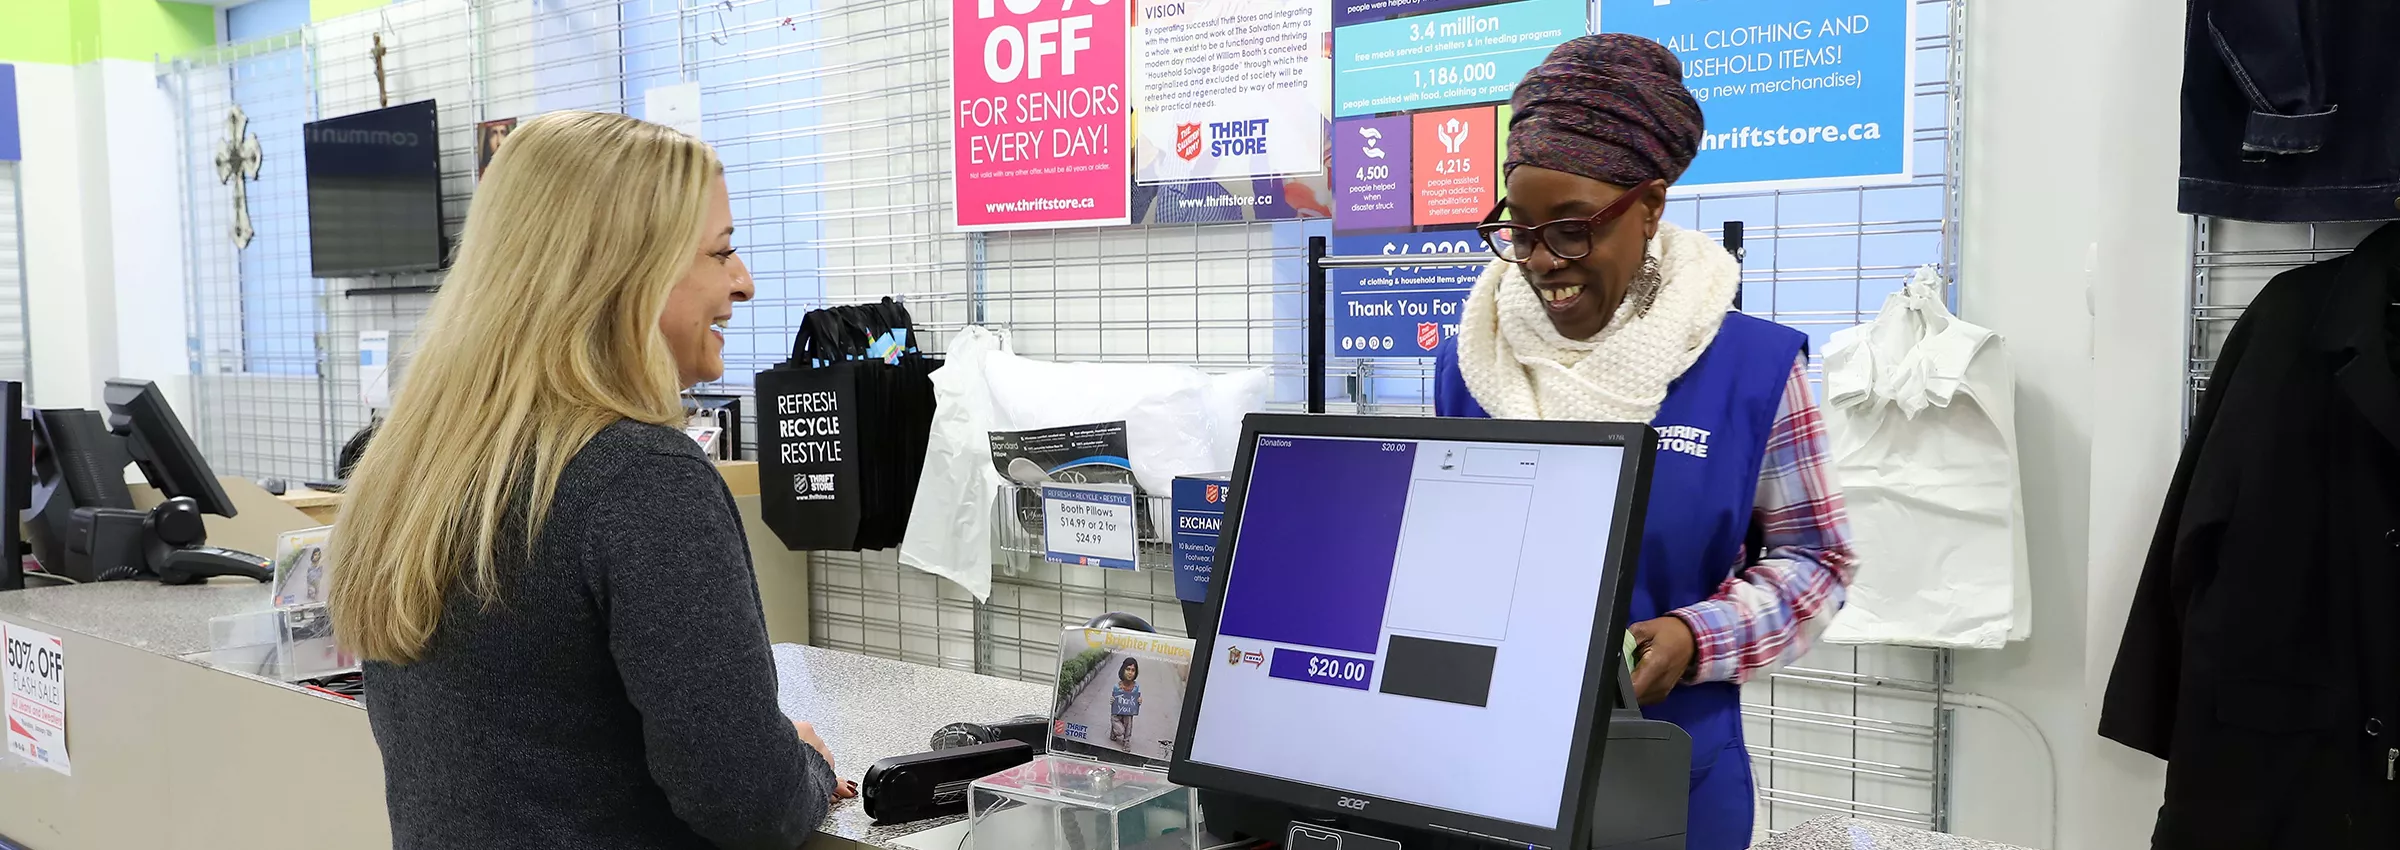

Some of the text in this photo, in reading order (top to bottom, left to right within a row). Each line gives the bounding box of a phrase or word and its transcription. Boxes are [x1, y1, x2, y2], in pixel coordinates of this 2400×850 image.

[1145, 2, 1185, 19] VISION
[1347, 1, 1387, 14] people were
[1145, 7, 1313, 36] By operating successful Thrift Stores and integrating
[1409, 16, 1499, 42] 3.4 million
[1145, 37, 1157, 46] with
[1158, 36, 1169, 44] the
[1170, 34, 1194, 43] mission
[1195, 31, 1208, 40] and
[1210, 29, 1226, 38] work
[1235, 26, 1247, 35] The
[1248, 23, 1280, 34] Salvation
[1282, 20, 1301, 29] Army
[1667, 14, 1869, 53] ALL CLOTHING AND
[983, 14, 1093, 84] OFF
[1173, 31, 1308, 54] we exist to be functioning and thriving
[1355, 28, 1562, 62] free meals served at shelters & in feeding programs
[1145, 42, 1308, 68] modern day model William Booth's conceived
[1681, 45, 1842, 79] USEHOLD ITEMS!
[1183, 66, 1211, 76] Salvage
[1243, 58, 1271, 69] through
[1272, 56, 1295, 66] which
[1296, 55, 1309, 63] the
[1145, 67, 1303, 92] marginalized and excluded of society will be
[1413, 61, 1496, 89] 1,186,000
[1713, 69, 1862, 99] new merchandise)
[1145, 79, 1308, 102] refreshed and regenerated by way of meeting
[1342, 86, 1487, 111] people assisted with clothing or
[960, 83, 1119, 129] FOR SENIORS
[1144, 104, 1159, 113] their
[1161, 101, 1192, 112] practical
[1180, 126, 1192, 139] THE
[1209, 118, 1269, 139] THRIFT
[1699, 121, 1881, 151] hriftstore.ca
[971, 123, 1108, 164] EVERY DAY!
[1211, 137, 1267, 158] STORE
[980, 171, 993, 179] valid
[1355, 165, 1389, 182] 4,500
[1435, 158, 1471, 176] 4,215
[1349, 182, 1396, 194] people helped
[1427, 176, 1479, 187] people assisted
[1179, 194, 1273, 209] www.thriftstore.ca
[1363, 193, 1382, 201] when
[1421, 188, 1448, 198] through
[1427, 196, 1479, 206] rehabilitation &
[986, 197, 1095, 213] www.thriftstore.ca
[1351, 201, 1394, 212] disaster struck
[1428, 206, 1479, 216] shelter services
[1359, 278, 1367, 286] of
[1367, 277, 1394, 287] clothing
[1400, 275, 1436, 285] household
[1436, 276, 1455, 284] items
[1456, 276, 1476, 284] given
[1347, 300, 1394, 317] Thank
[1398, 299, 1428, 316] You
[1432, 299, 1458, 316] For
[777, 391, 838, 415] REFRESH
[779, 416, 840, 438] RECYCLE
[1653, 425, 1711, 443] THRIFT
[781, 440, 842, 464] RESTYLE
[991, 441, 1019, 450] Standard
[1260, 438, 1406, 452] Donations $20.00
[808, 473, 835, 483] THRIFT
[811, 482, 835, 492] STORE
[1047, 490, 1127, 504] REFRESH RECYCLE RESTYLE
[1060, 503, 1113, 518] Booth Pillows
[1060, 517, 1086, 528] $14.99
[1098, 521, 1104, 531] 2
[1105, 522, 1116, 532] for
[1179, 516, 1222, 530] EXCHAN
[1076, 532, 1102, 544] $24.99
[1185, 543, 1204, 551] Business
[1105, 631, 1148, 651] Brighter
[1150, 640, 1191, 657] Futures
[8, 637, 63, 683] 50% OFF
[1308, 655, 1365, 682] $20.00
[13, 671, 60, 706] FLASH SALE!
[1065, 730, 1088, 740] STORE
[1066, 722, 1088, 733] THRIFT
[1337, 796, 1370, 811] acer
